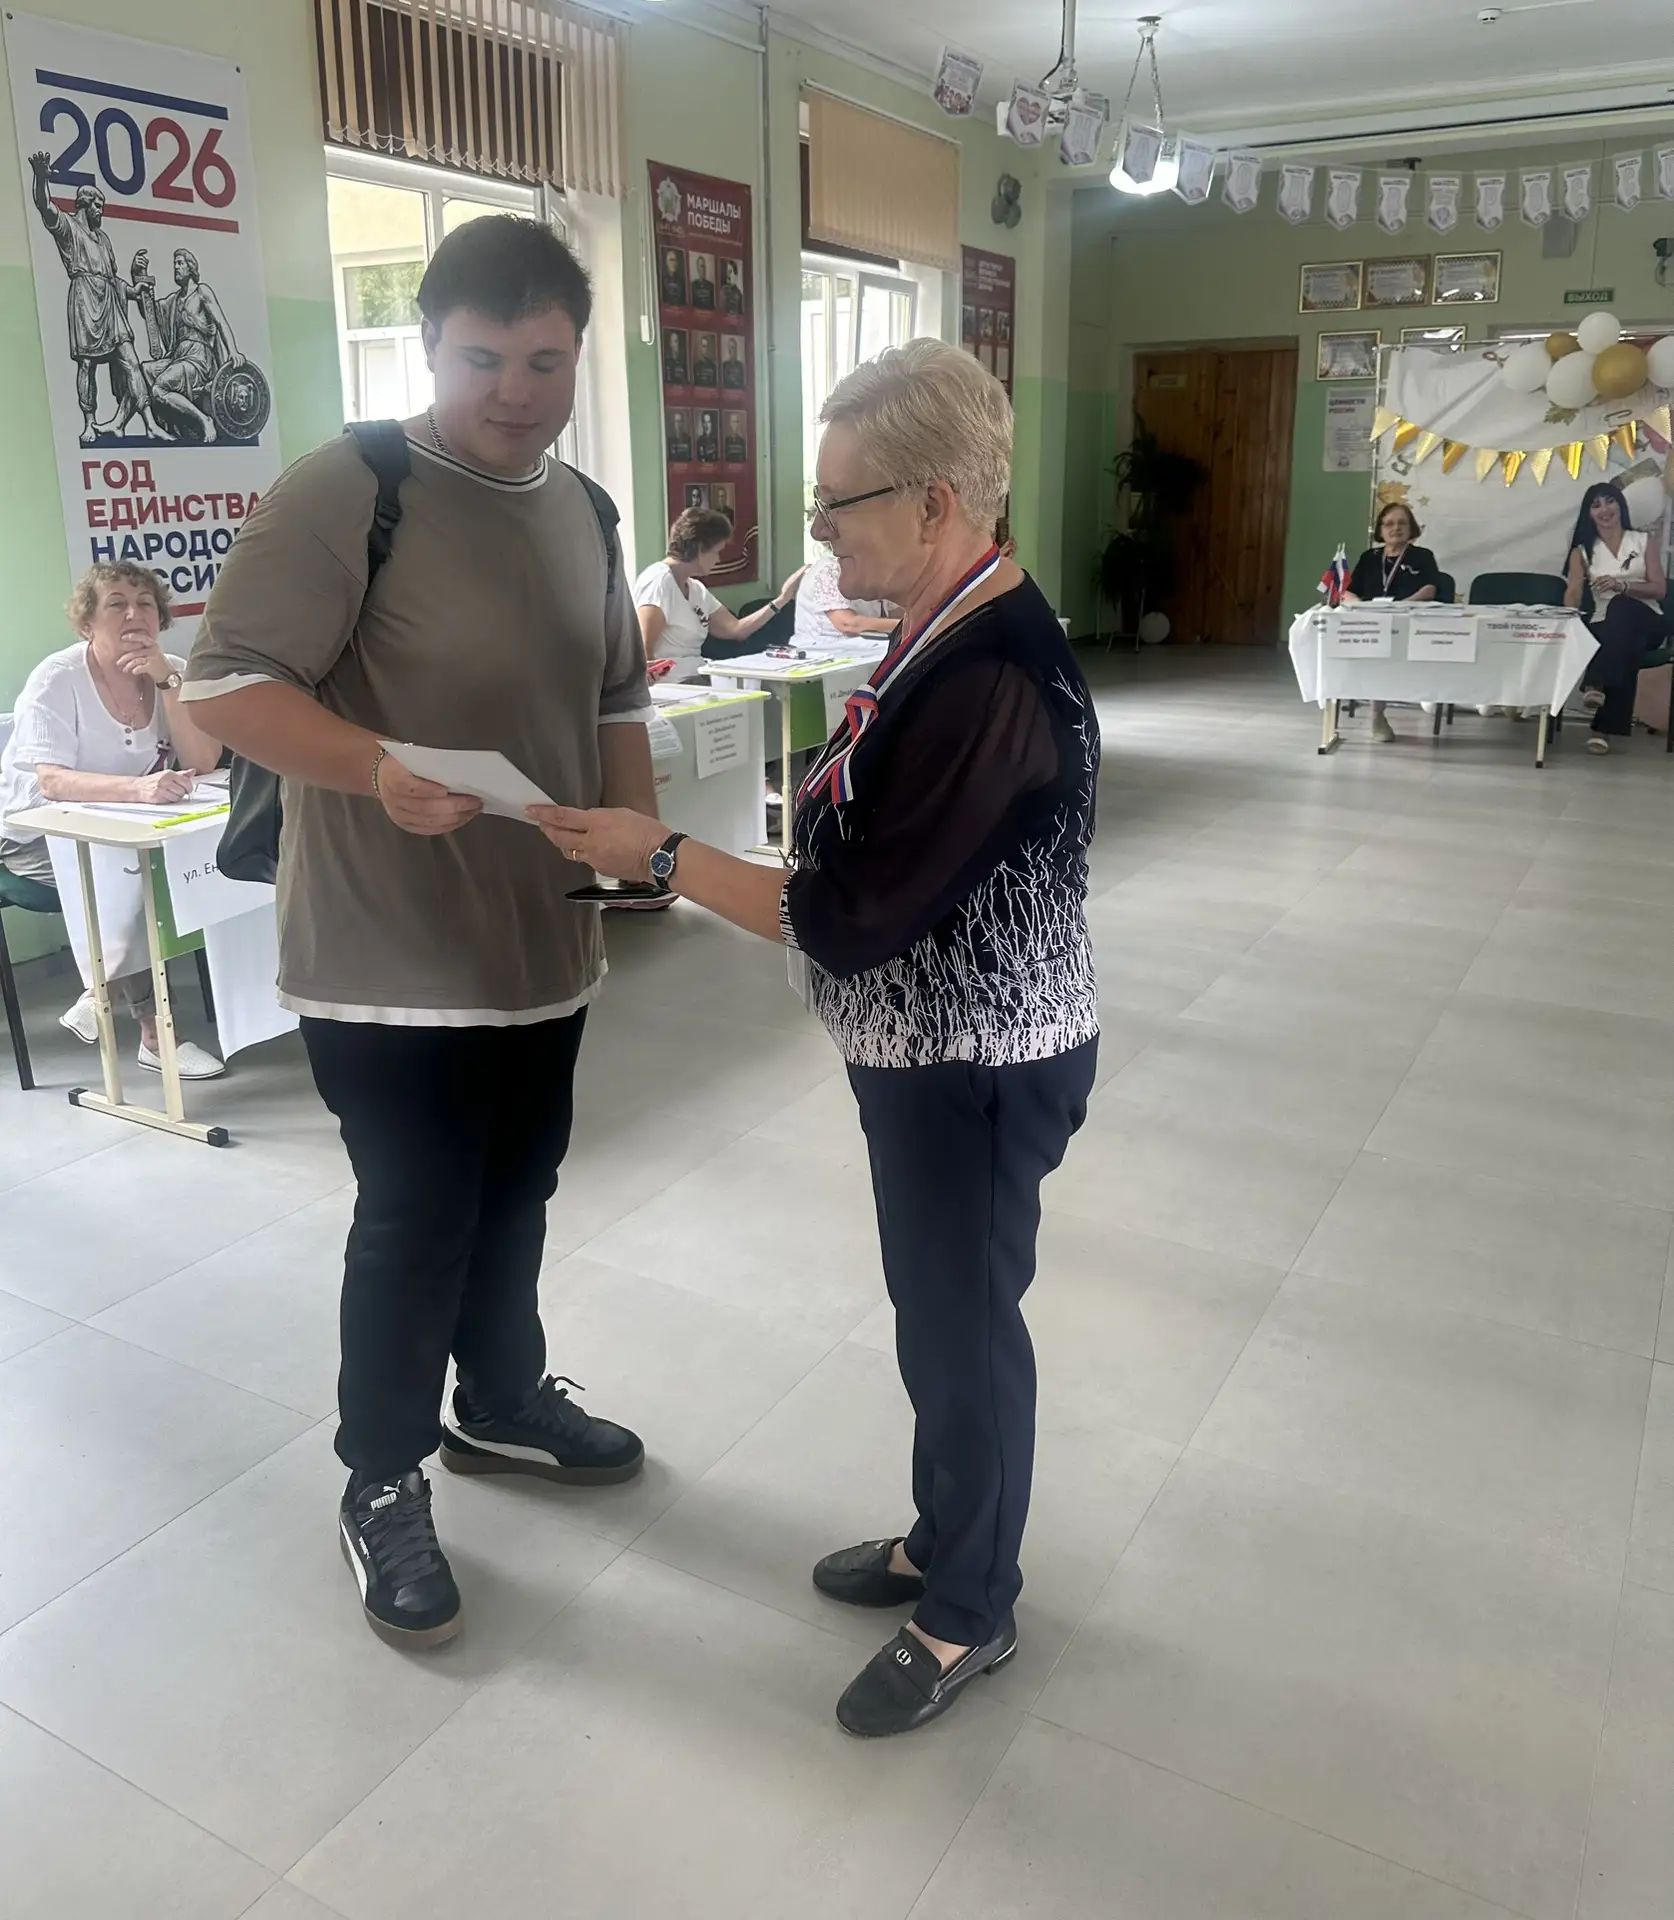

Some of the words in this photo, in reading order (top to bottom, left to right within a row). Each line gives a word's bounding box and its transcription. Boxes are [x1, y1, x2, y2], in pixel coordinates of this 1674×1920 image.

[40, 97, 236, 208] 2026
[687, 193, 742, 219] МАРШАЛЫ
[688, 211, 731, 234] ПОБЕДЫ
[82, 460, 156, 493] ГОД
[90, 527, 240, 564] НАРОДО
[183, 869, 201, 884] ул.
[205, 862, 220, 875] Ен
[370, 1492, 397, 1511] PUMA
